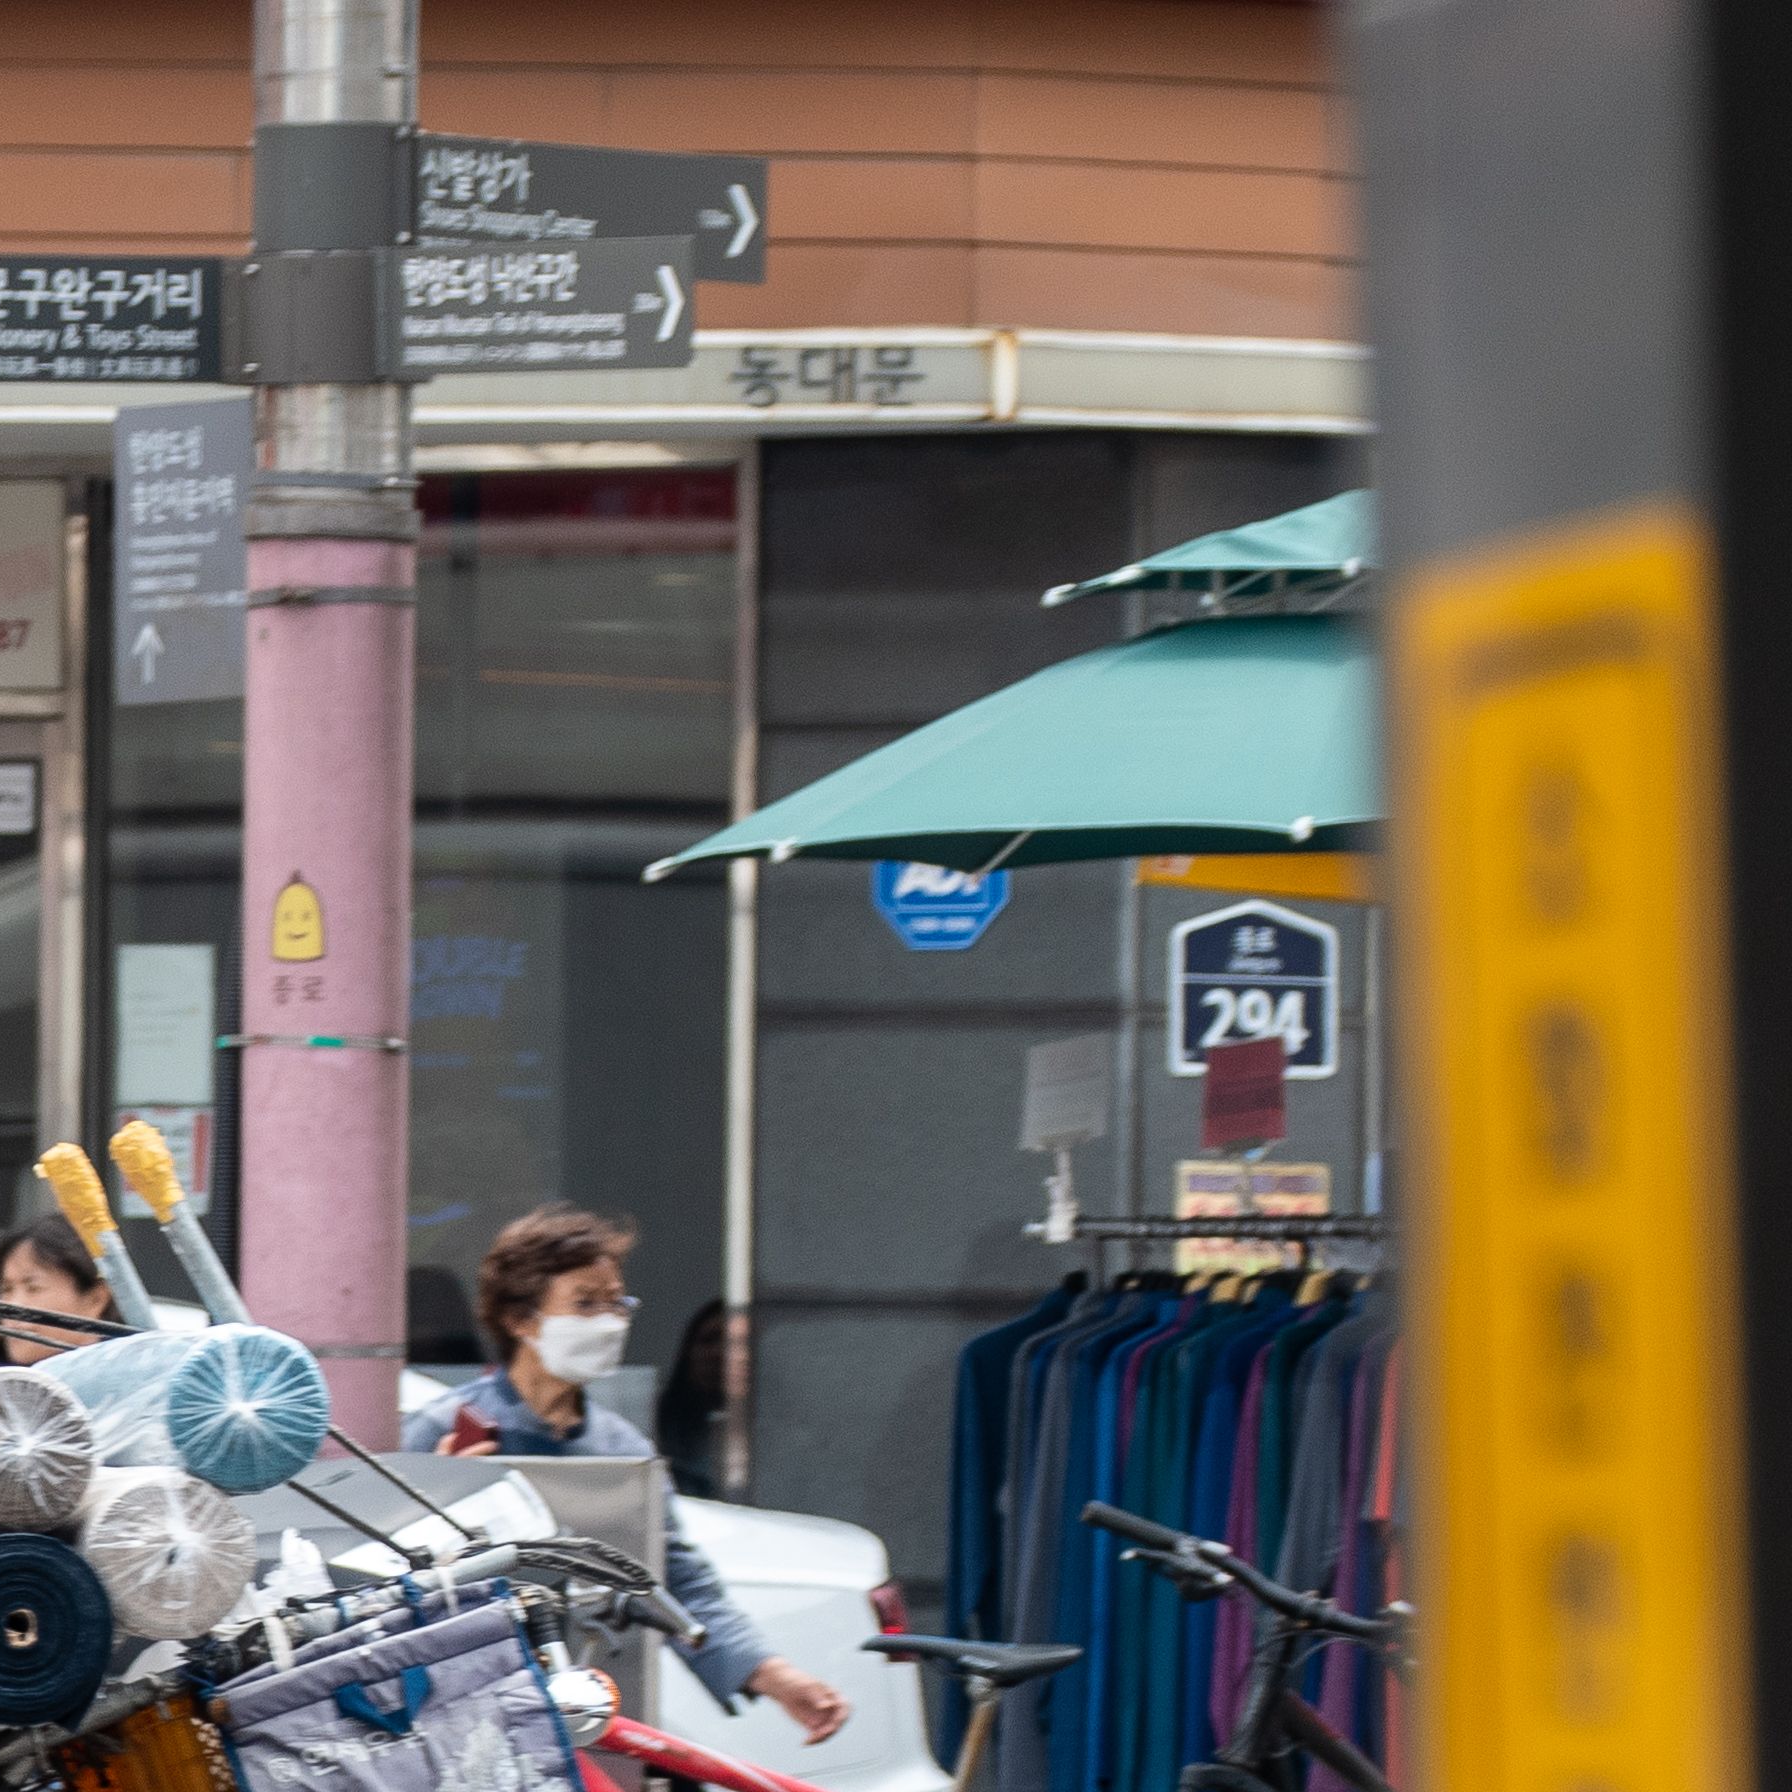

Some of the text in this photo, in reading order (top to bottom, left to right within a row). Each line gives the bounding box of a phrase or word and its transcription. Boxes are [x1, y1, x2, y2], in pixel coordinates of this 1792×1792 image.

[61, 322, 84, 350] &
[85, 322, 134, 352] Toys
[135, 323, 200, 350] Street
[728, 346, 926, 407] 동대문
[1198, 985, 1311, 1058] 294
